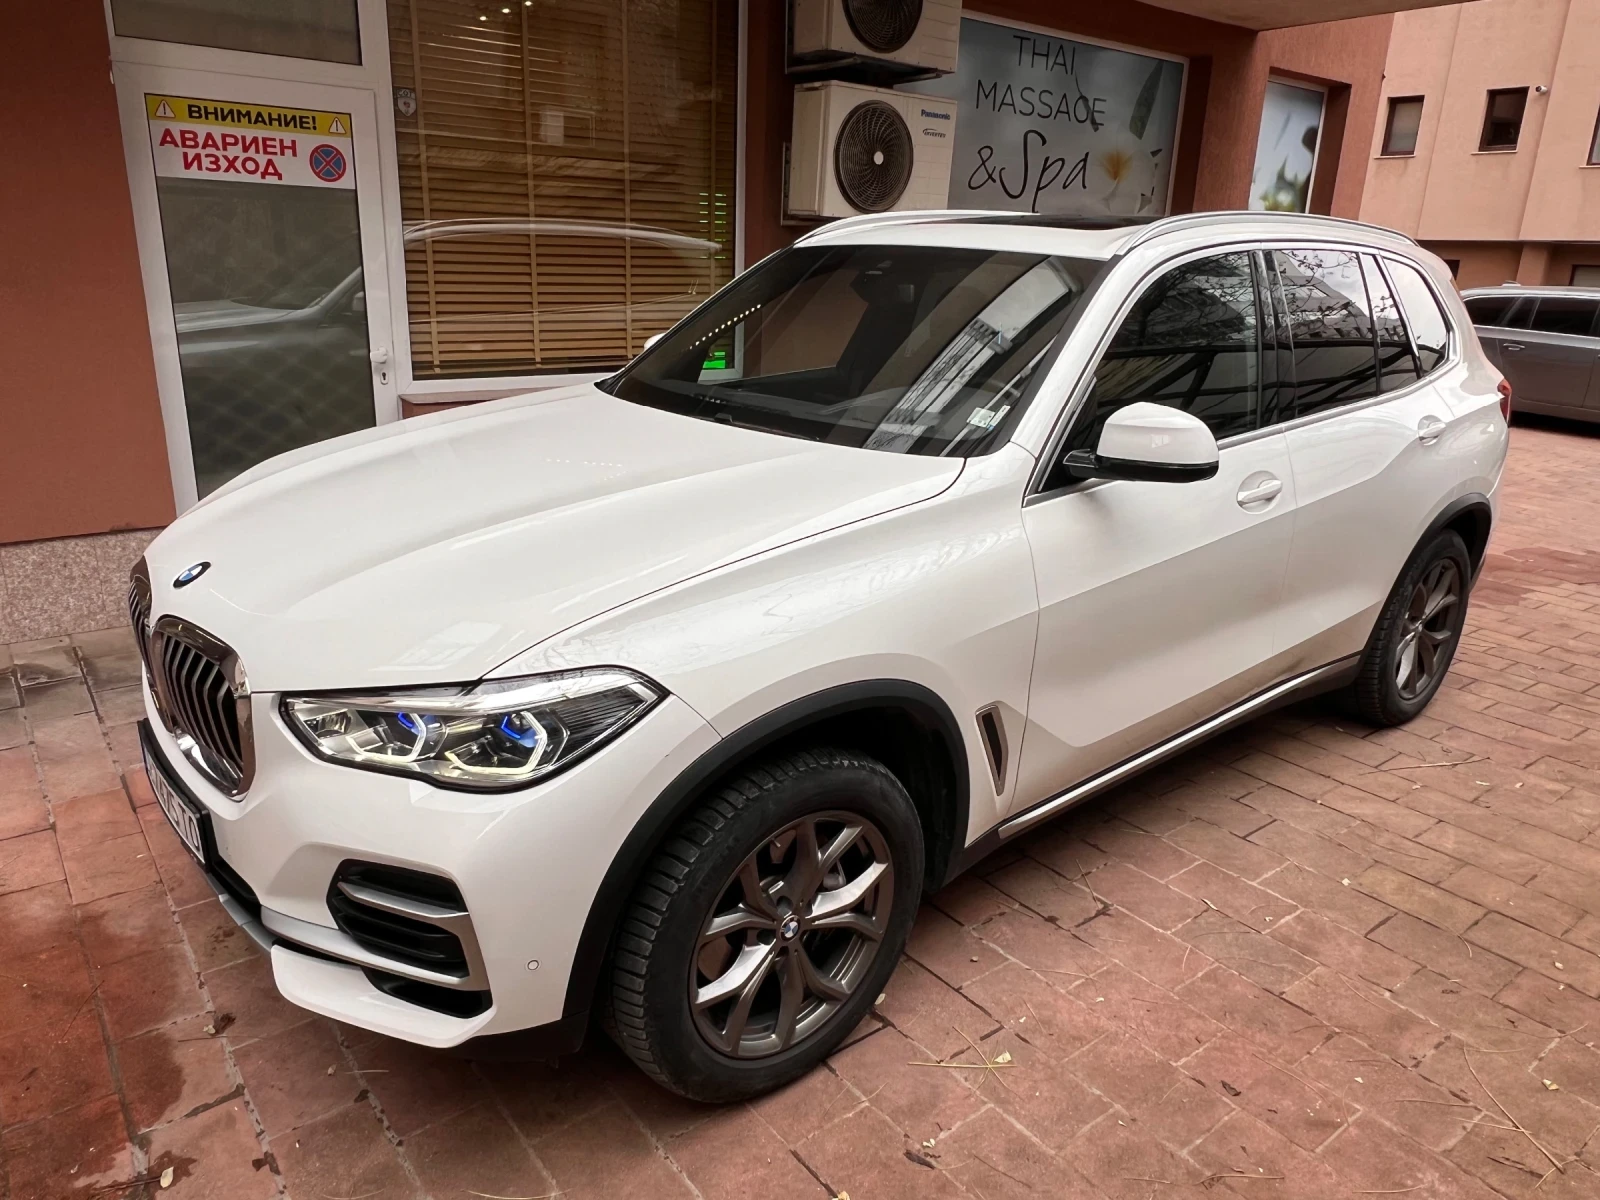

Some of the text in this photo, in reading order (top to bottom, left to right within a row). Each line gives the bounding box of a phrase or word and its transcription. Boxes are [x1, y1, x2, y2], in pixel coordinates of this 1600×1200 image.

[1013, 35, 1076, 75] THAI
[187, 104, 317, 130] ВНИМАНИЕ!
[921, 109, 950, 120] Panasonic
[159, 128, 297, 157] АВАРИЕН
[182, 152, 282, 180] ИЗХОД
